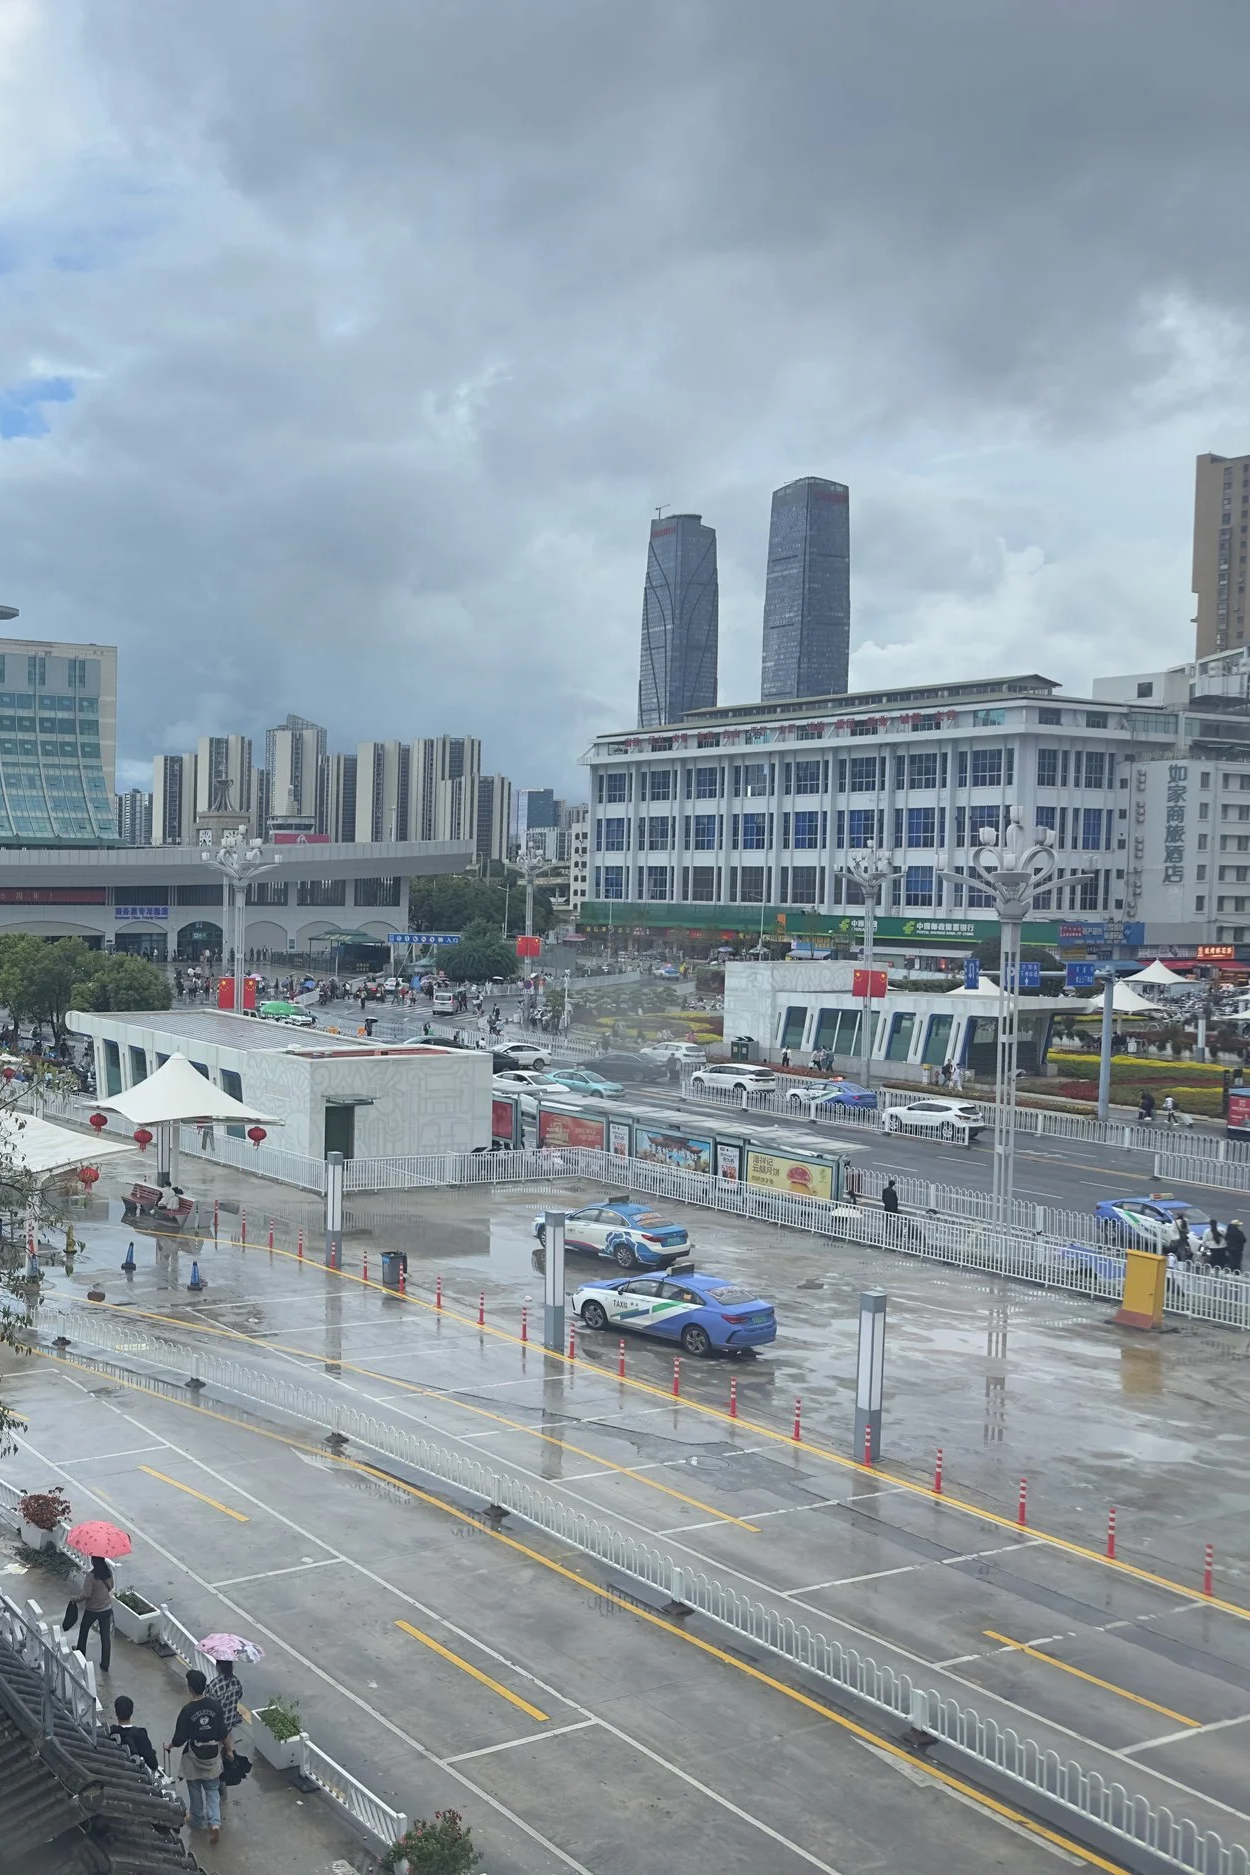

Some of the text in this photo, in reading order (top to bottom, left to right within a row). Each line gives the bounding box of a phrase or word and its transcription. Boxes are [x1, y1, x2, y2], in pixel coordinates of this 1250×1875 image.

[1162, 764, 1187, 883] 如家商旅酒店
[851, 920, 878, 928] 中国政
